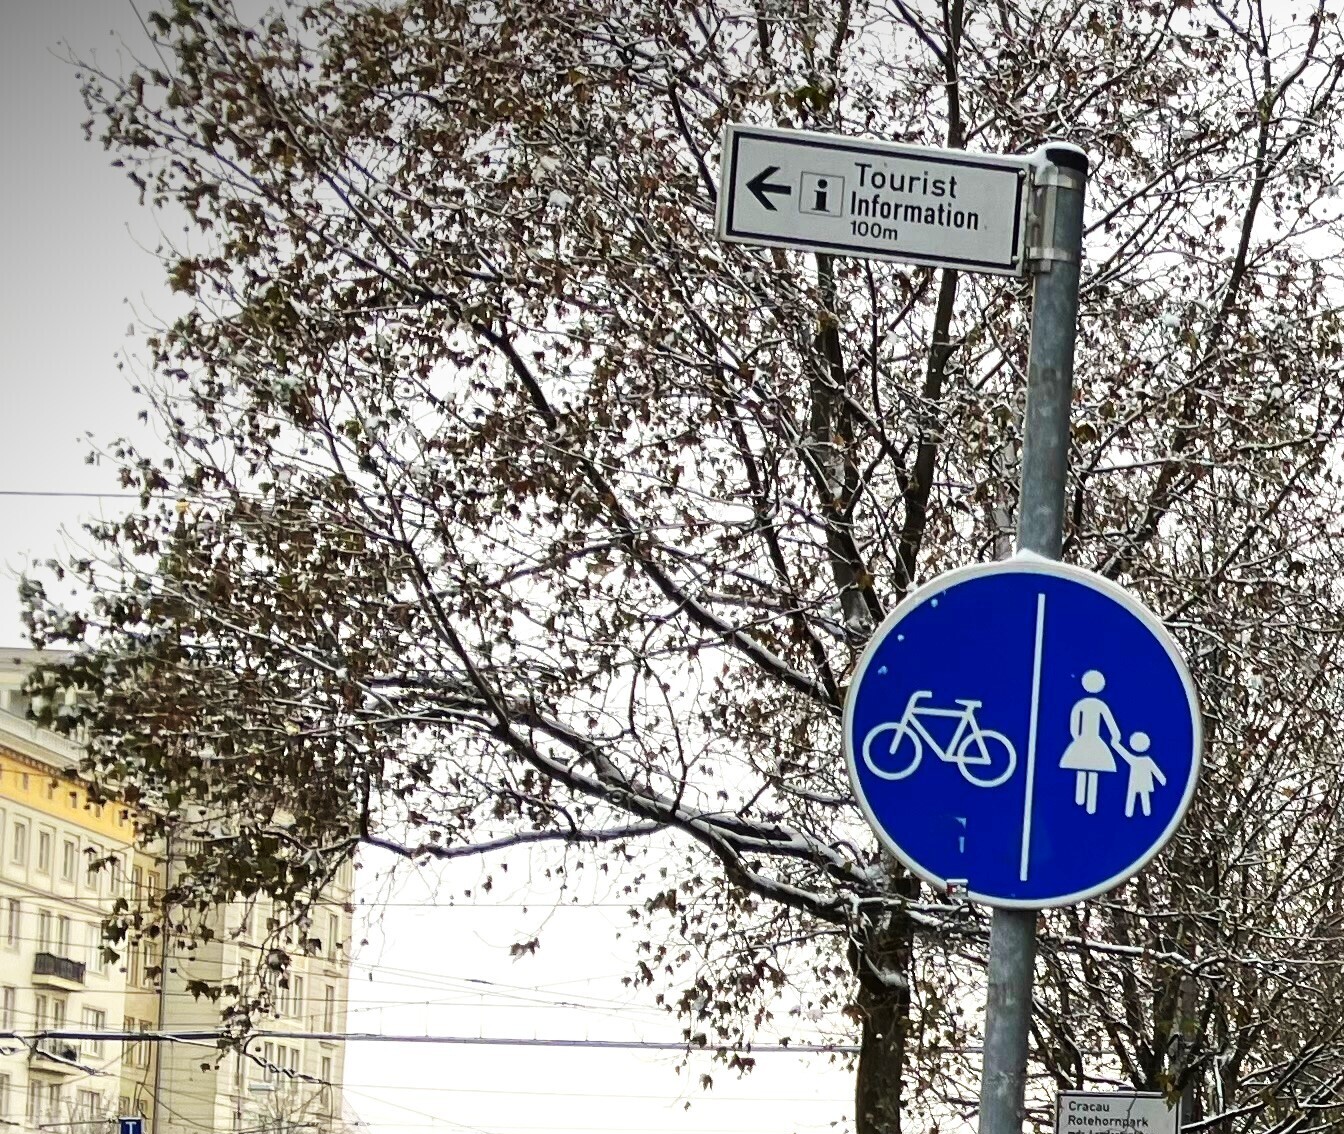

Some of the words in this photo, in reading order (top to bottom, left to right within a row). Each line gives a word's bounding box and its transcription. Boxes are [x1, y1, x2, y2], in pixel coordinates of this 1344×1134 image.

[855, 162, 957, 198] Tourist
[851, 191, 978, 230] Information
[851, 221, 898, 241] 100m
[1068, 1101, 1110, 1111] Cracau
[1068, 1115, 1149, 1128] Rotehornpark
